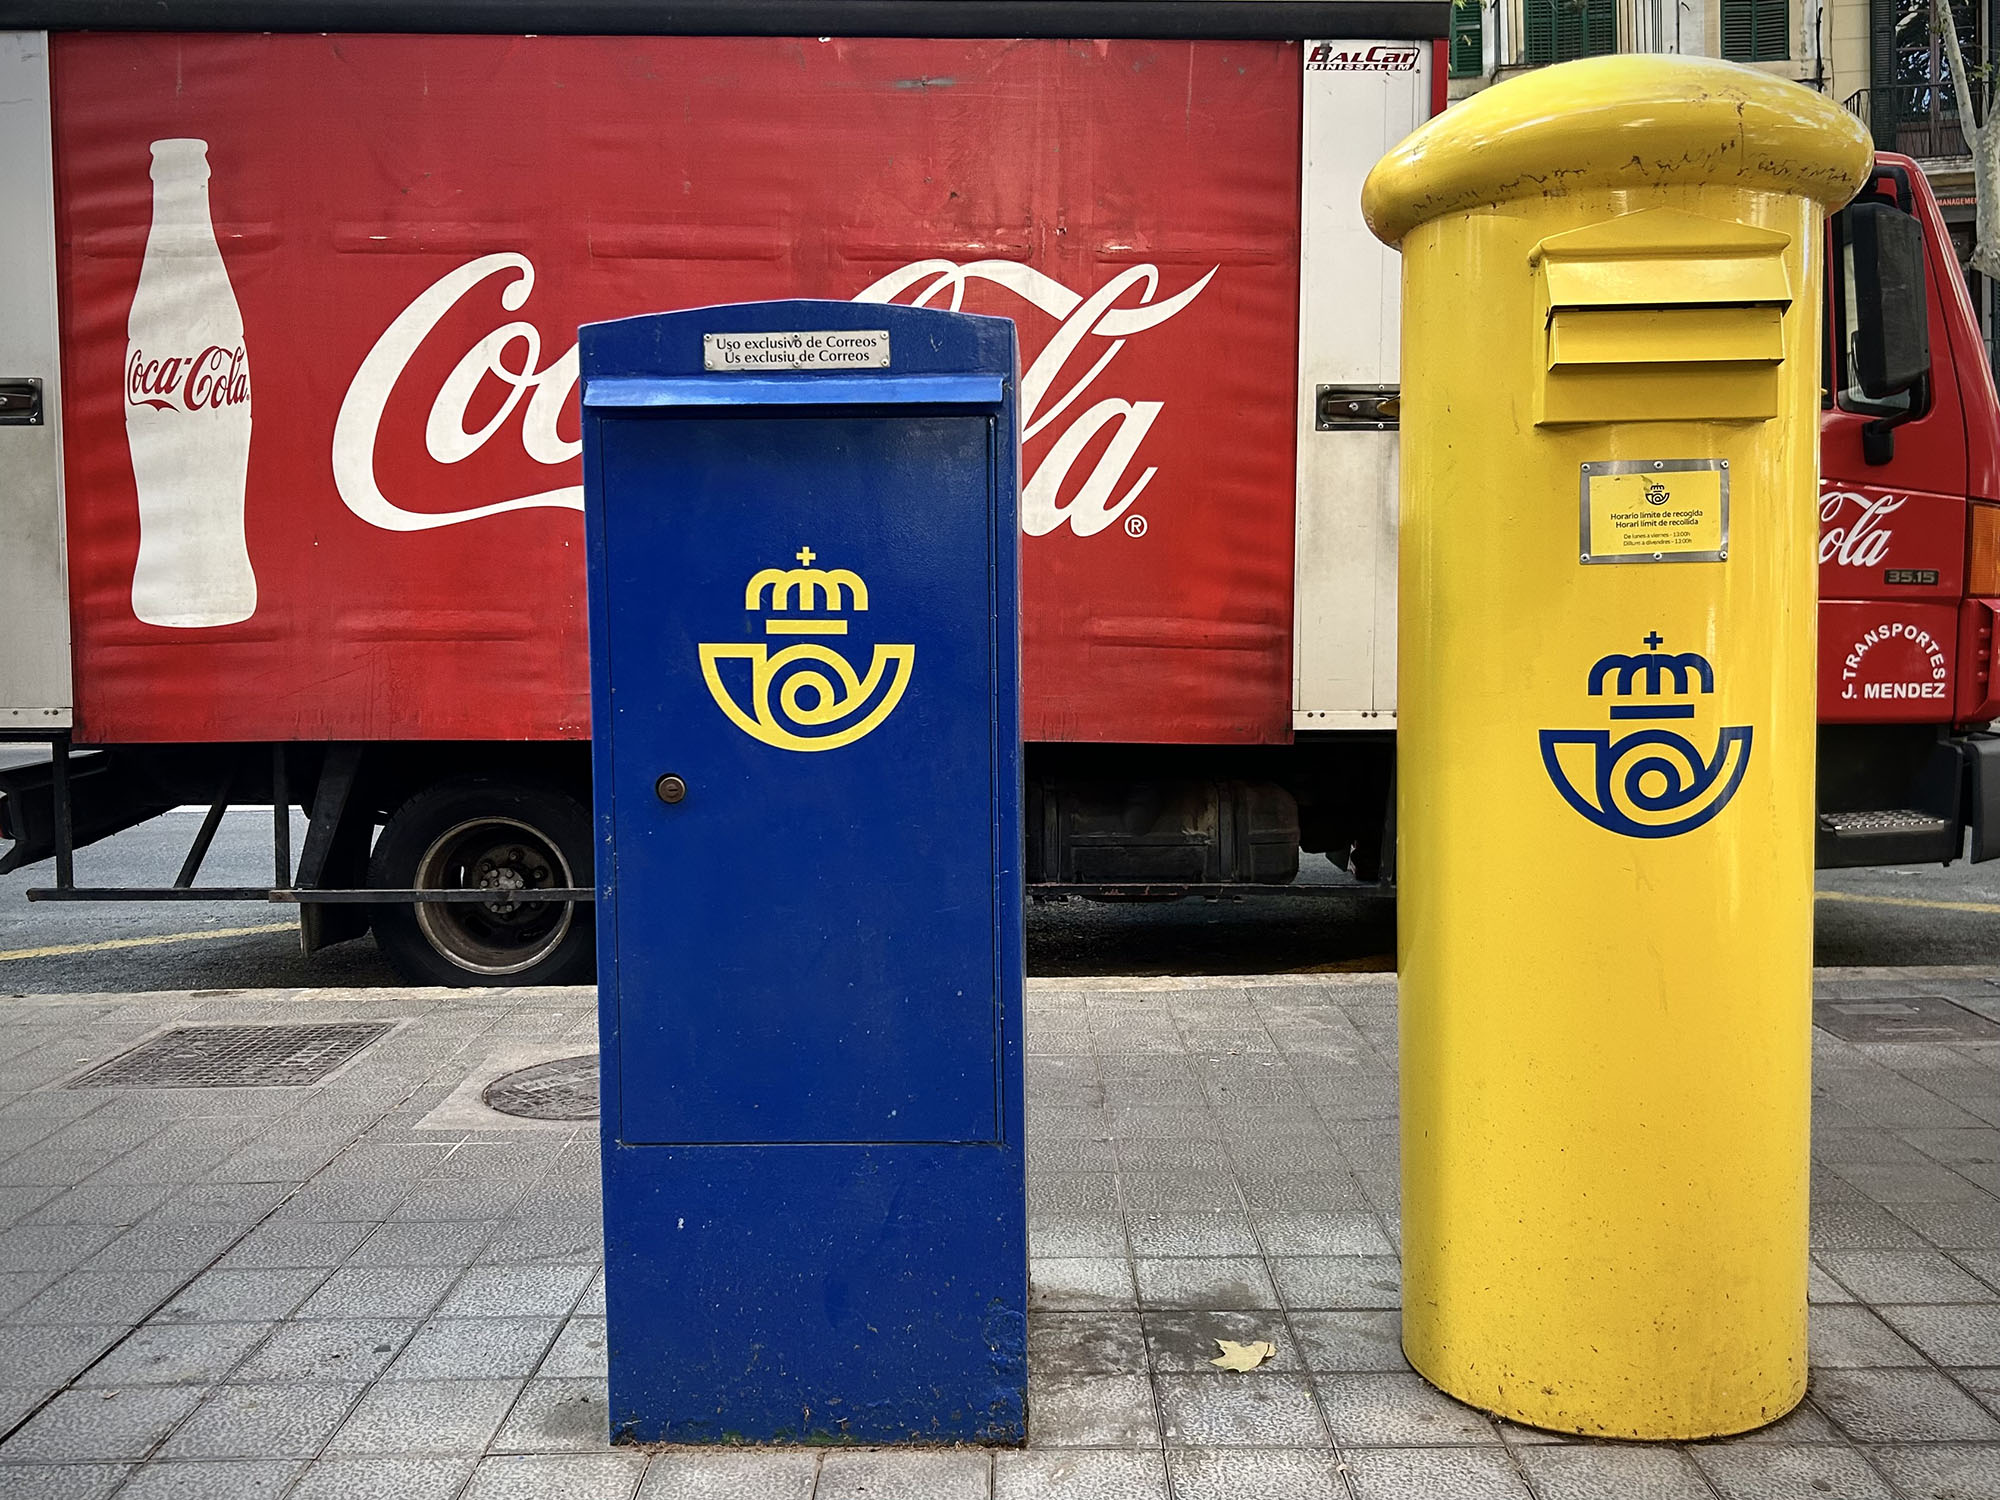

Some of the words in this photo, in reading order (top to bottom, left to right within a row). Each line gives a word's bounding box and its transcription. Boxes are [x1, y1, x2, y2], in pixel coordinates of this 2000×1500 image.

[716, 337, 741, 350] Uso
[744, 336, 803, 350] exclusivo
[806, 337, 823, 348] de
[826, 337, 877, 348] Correos
[724, 349, 741, 363] Ús
[744, 350, 796, 363] exclusiu
[799, 350, 815, 362] de
[818, 350, 870, 362] Correos
[127, 345, 249, 413] Coca-Cola
[1610, 512, 1639, 521] Horario
[1673, 509, 1704, 520] recogida
[1616, 520, 1639, 528] Horari
[1887, 572, 1936, 583] 35.15
[1843, 623, 1946, 680] TRANSPORTES
[1841, 683, 1857, 699] J.
[1864, 683, 1946, 699] MENDEZ
